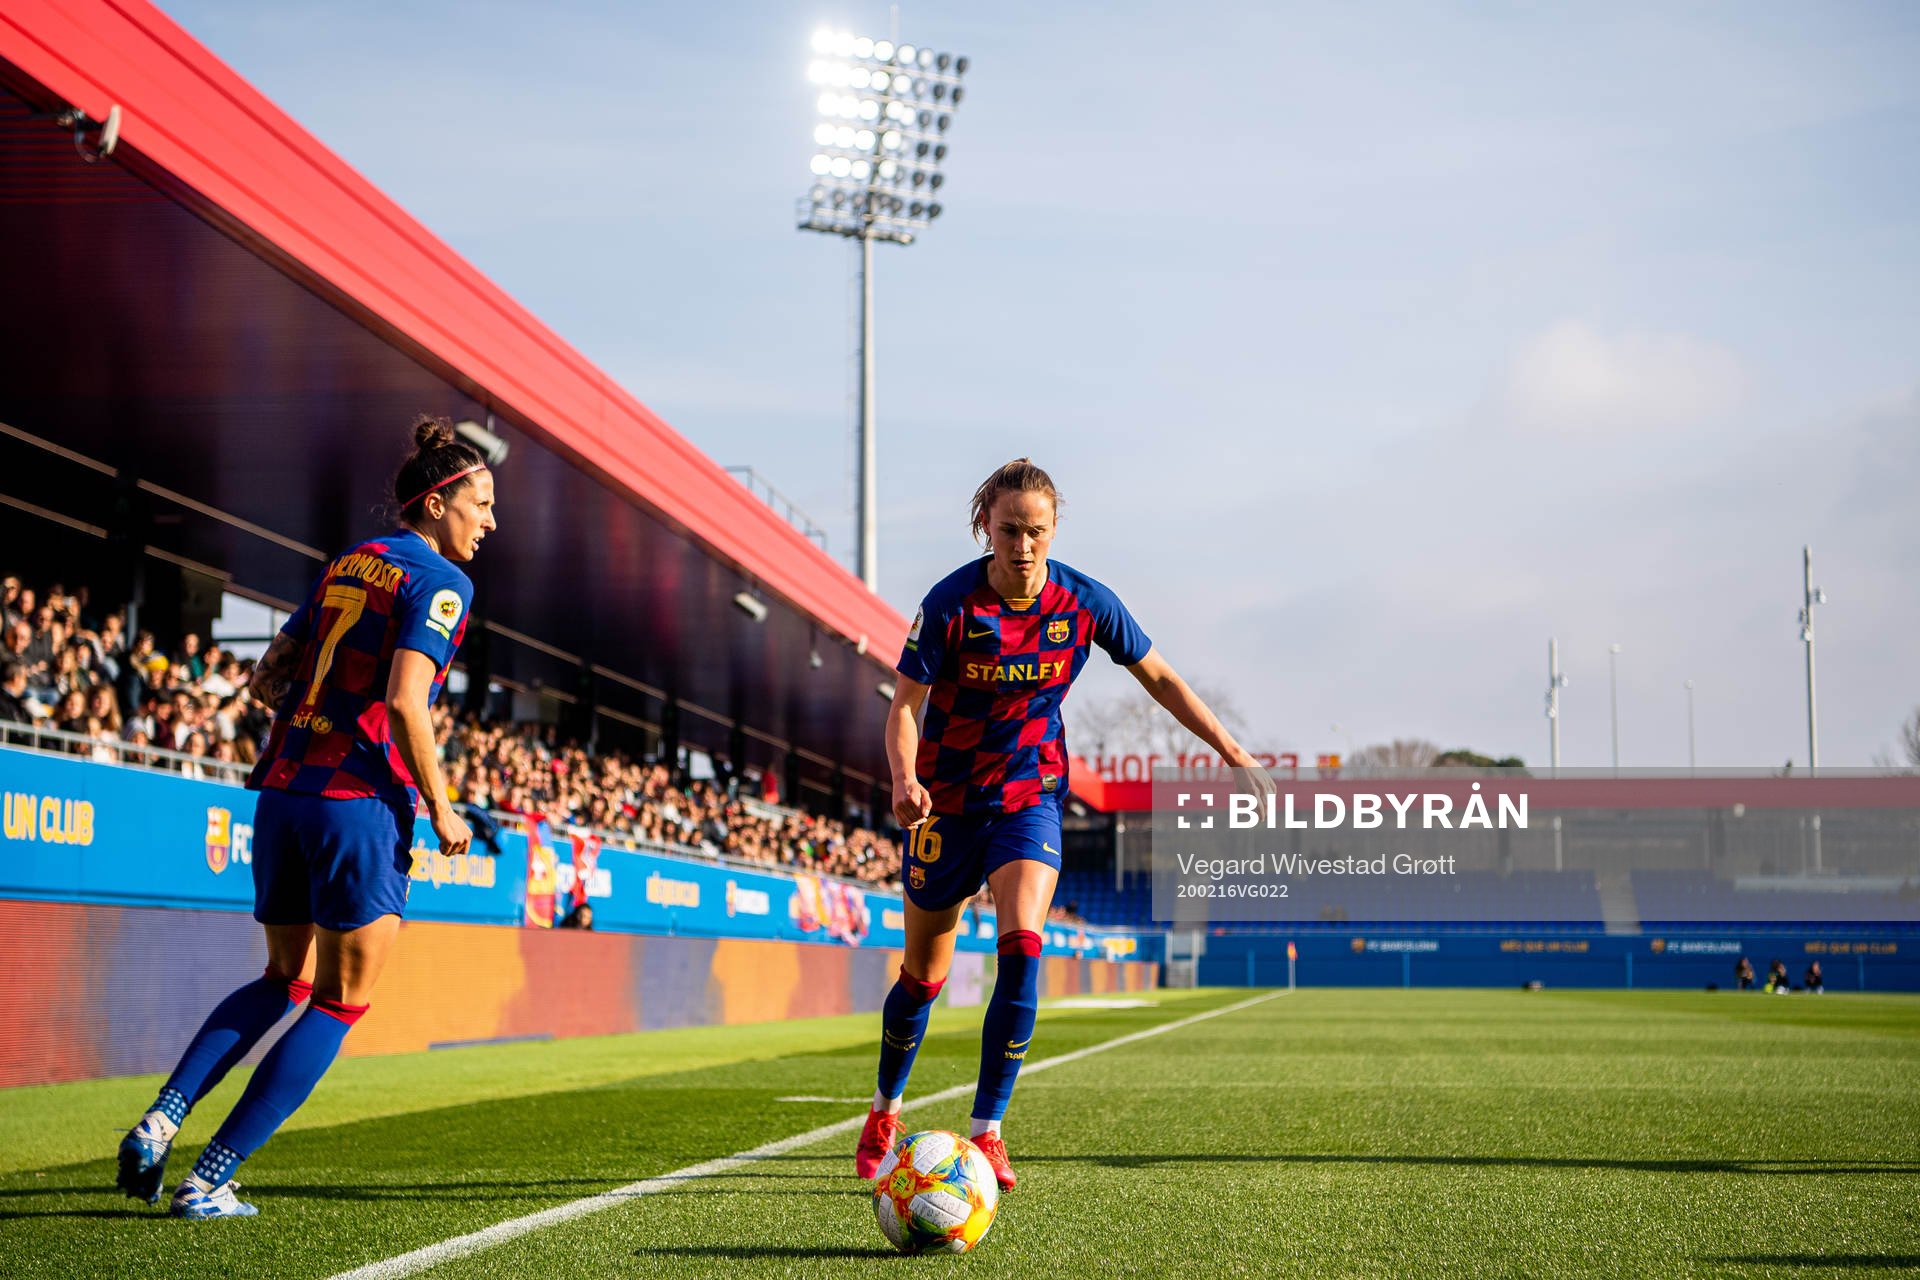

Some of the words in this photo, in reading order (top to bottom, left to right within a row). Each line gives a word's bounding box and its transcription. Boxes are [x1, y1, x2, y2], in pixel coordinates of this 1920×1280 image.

[305, 584, 368, 706] 7
[966, 660, 1065, 682] STANLEY
[3, 791, 38, 841] UN
[39, 795, 95, 847] CLUB
[908, 815, 942, 864] 16
